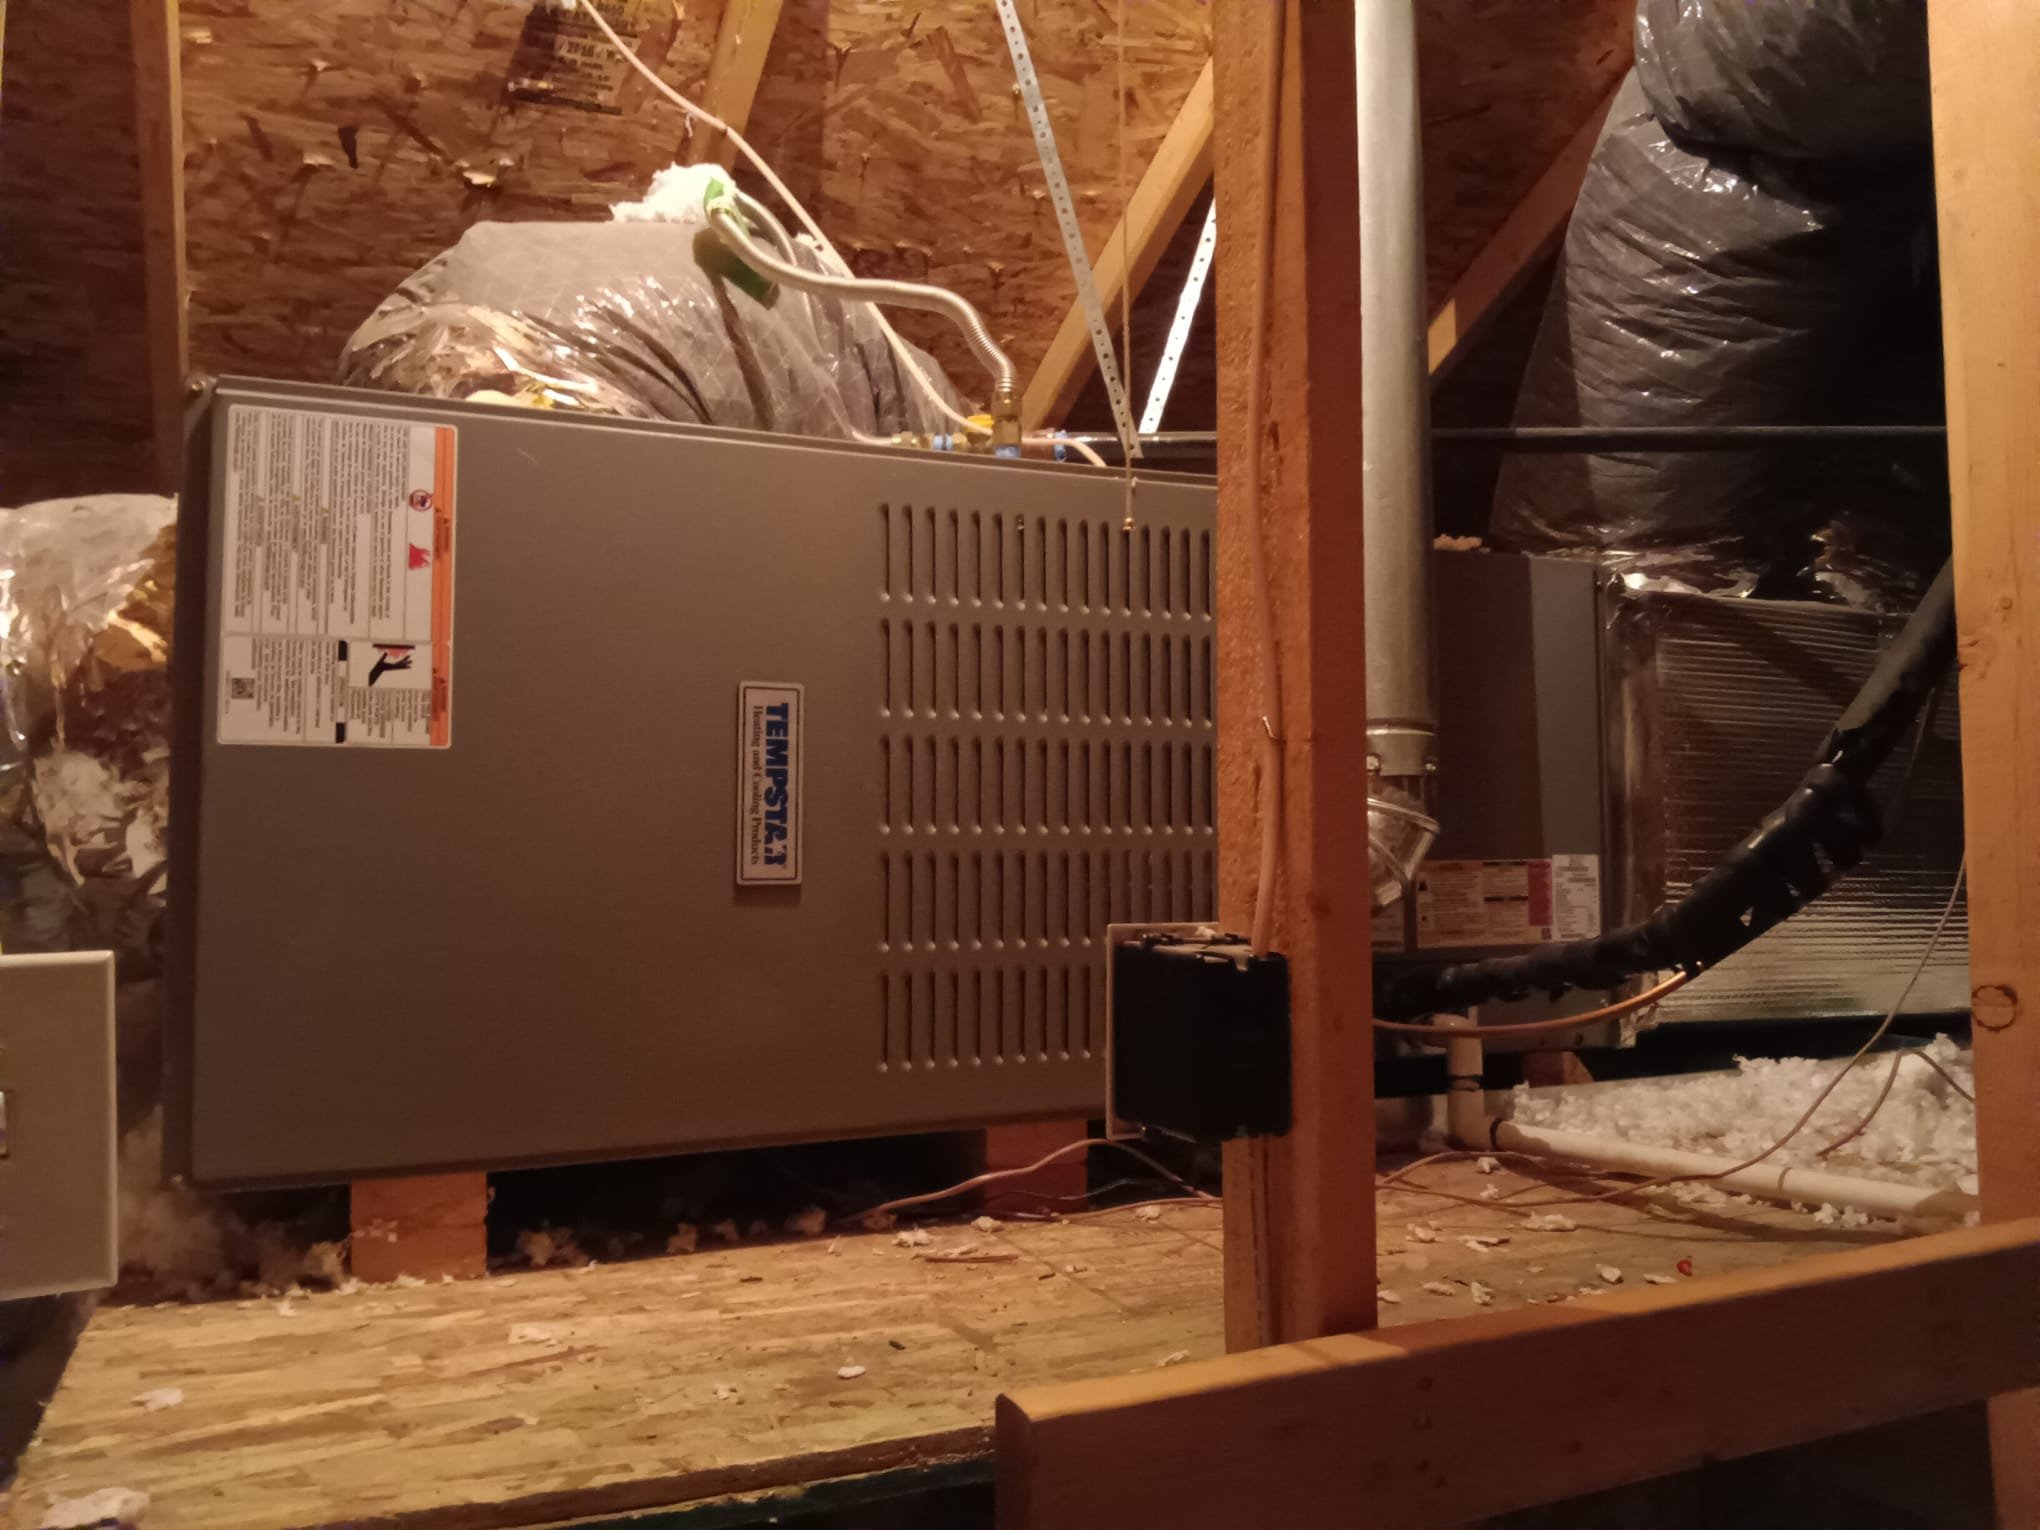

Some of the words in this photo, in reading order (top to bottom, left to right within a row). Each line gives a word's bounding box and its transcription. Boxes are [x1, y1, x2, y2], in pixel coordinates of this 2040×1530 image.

[752, 705, 763, 748] Heating
[752, 749, 763, 770] and
[751, 772, 763, 815] Cooling
[764, 702, 789, 865] TEMPSTAR
[750, 817, 763, 865] Products
